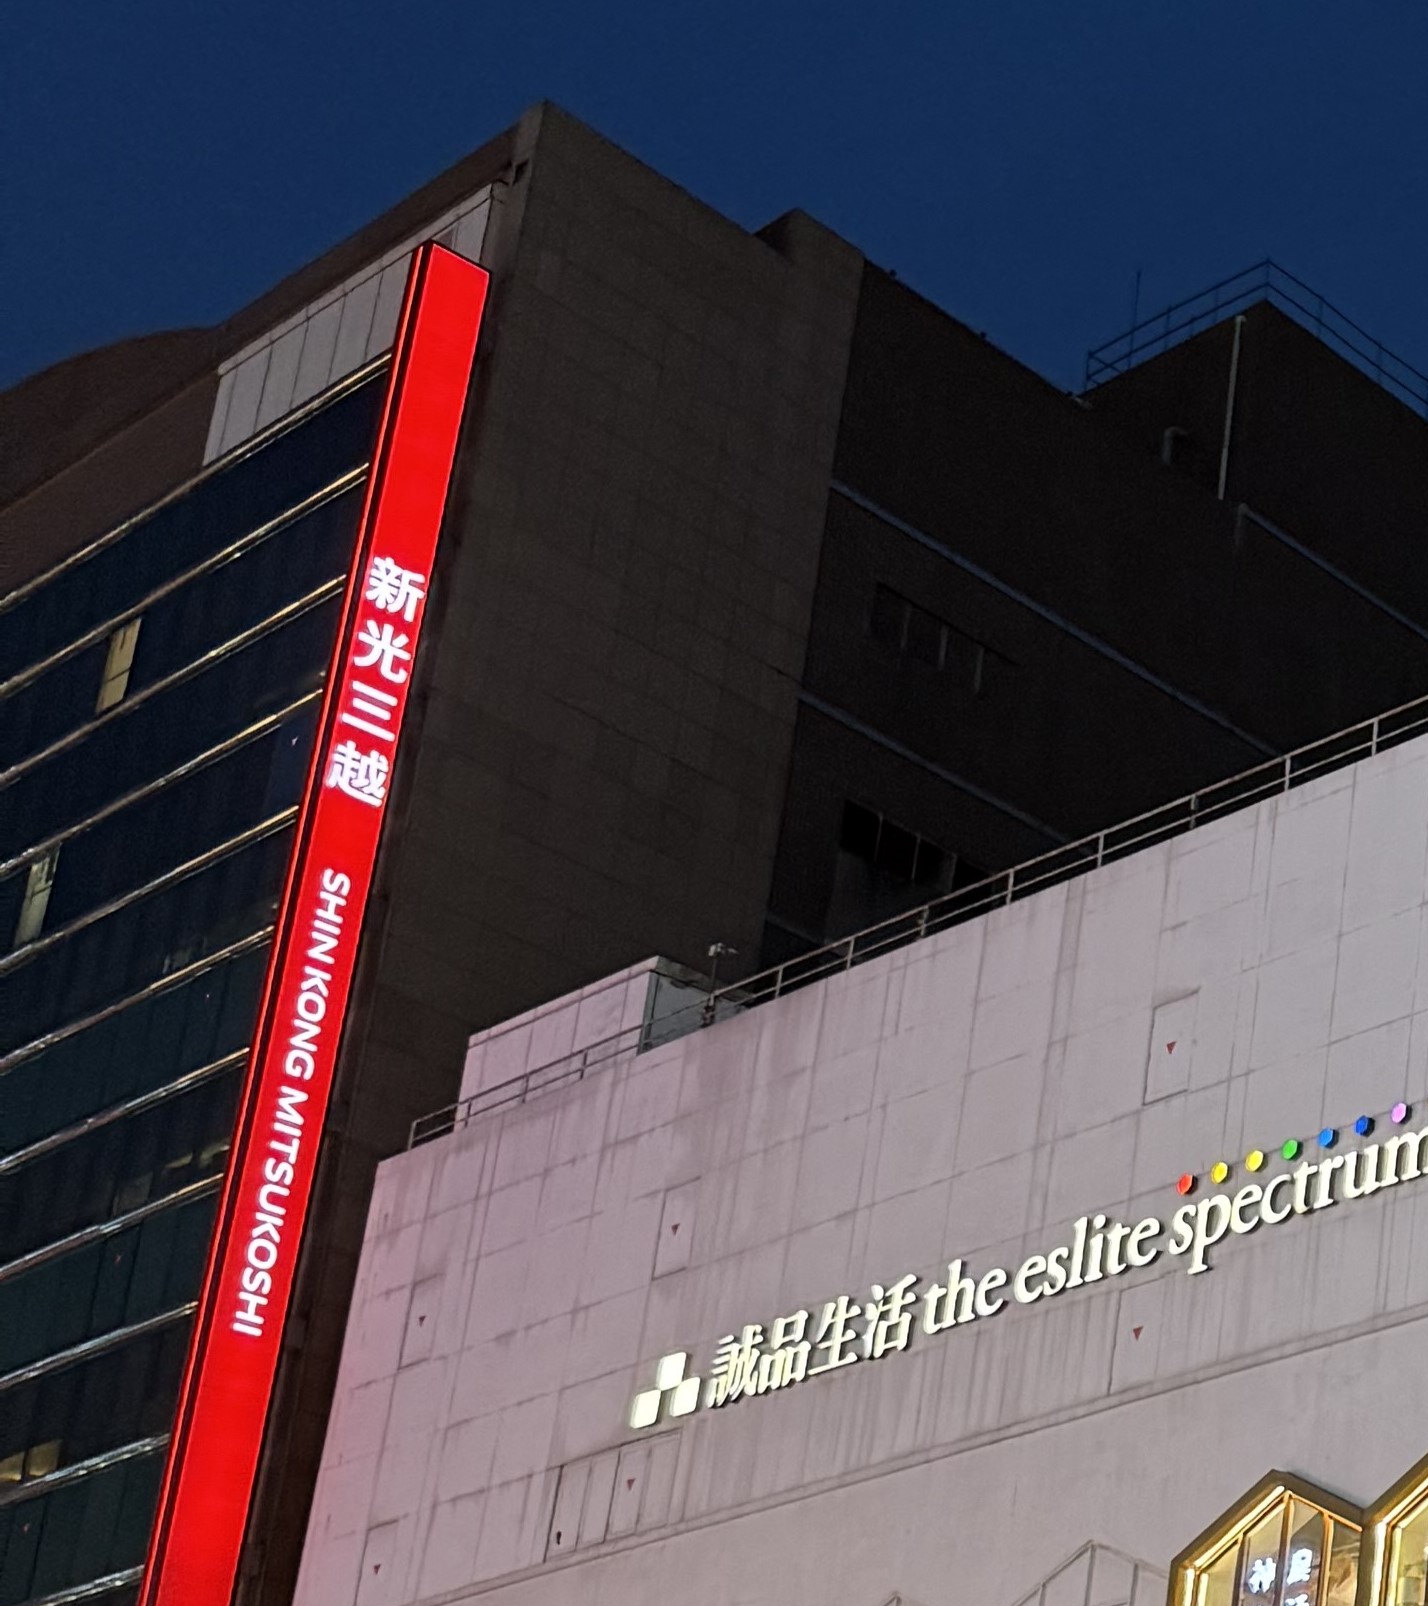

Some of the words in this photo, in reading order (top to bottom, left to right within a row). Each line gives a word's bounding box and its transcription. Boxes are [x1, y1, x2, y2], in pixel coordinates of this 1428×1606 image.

[322, 556, 426, 808] 新光三越
[306, 868, 351, 966] SHIN
[284, 965, 332, 1081] KONG
[232, 1085, 309, 1337] MITSUKOSHI
[705, 1273, 918, 1408] 誠品生活
[923, 1259, 1008, 1335] the
[1013, 1214, 1161, 1304] eslite
